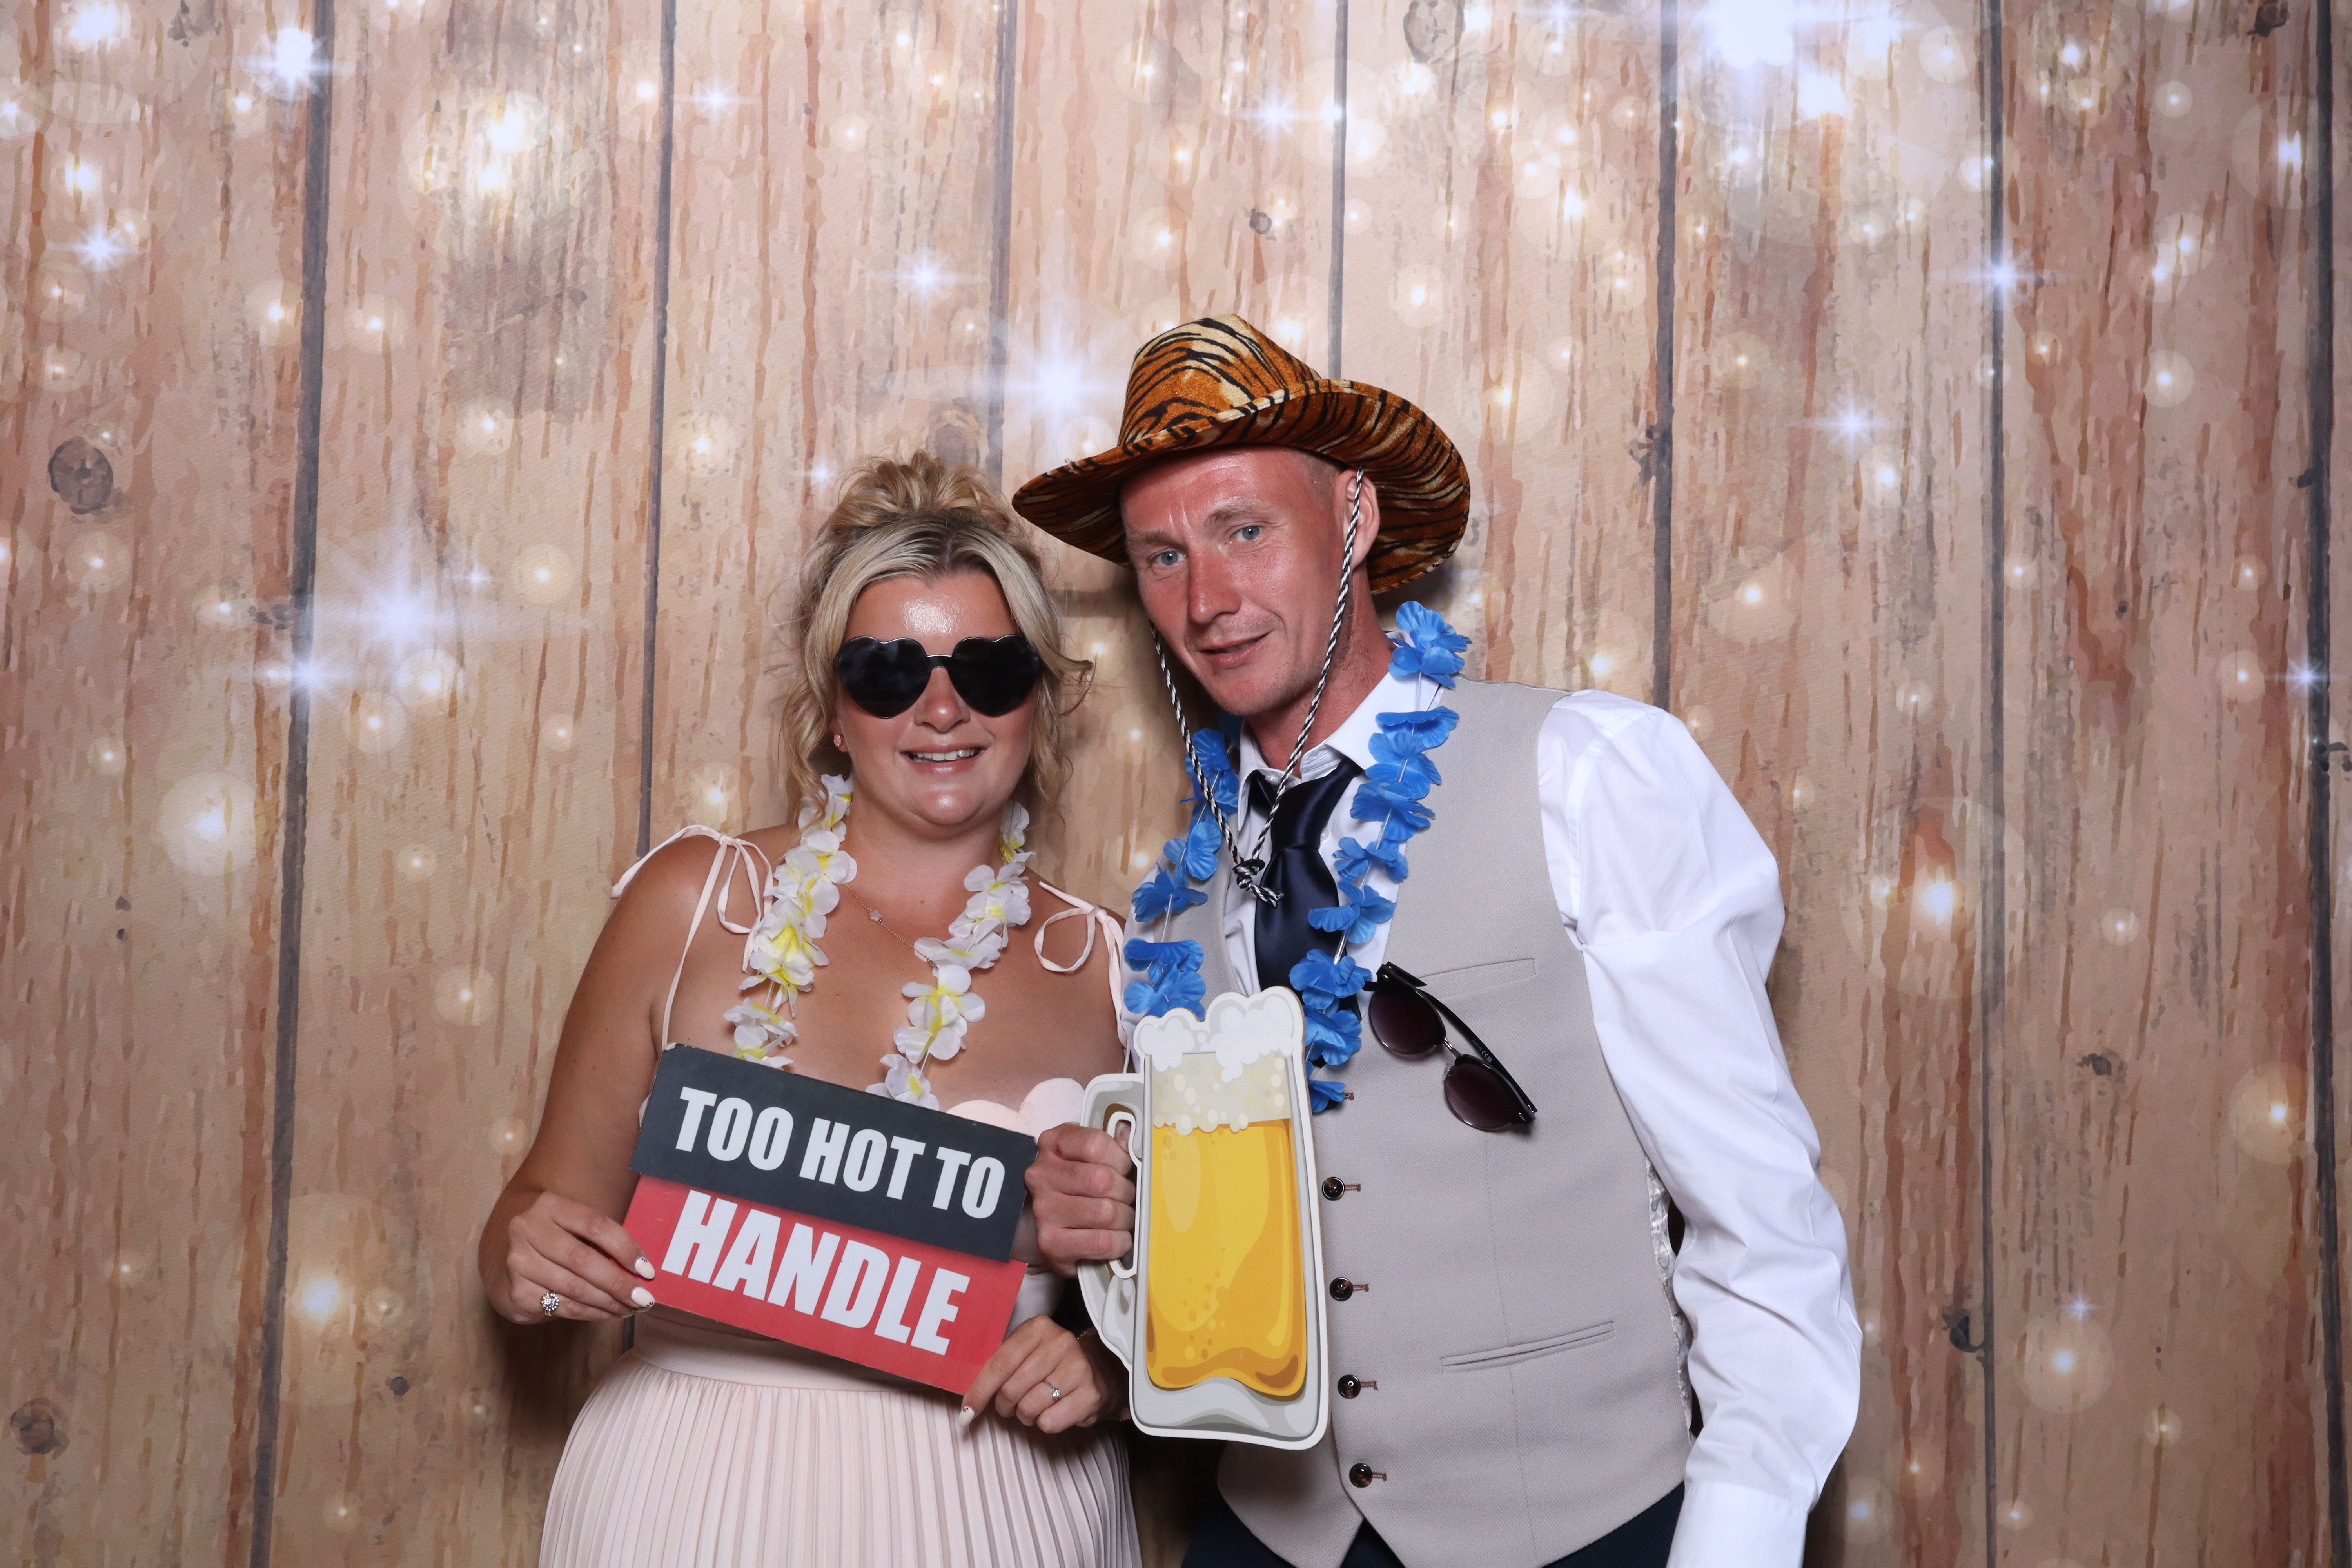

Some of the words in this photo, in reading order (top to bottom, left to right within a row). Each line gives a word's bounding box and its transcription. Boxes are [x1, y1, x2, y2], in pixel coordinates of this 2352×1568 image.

[676, 1086, 793, 1171] TOO
[799, 1117, 926, 1200] HOT
[932, 1146, 1005, 1219] TO
[661, 1189, 971, 1355] HANDLE
